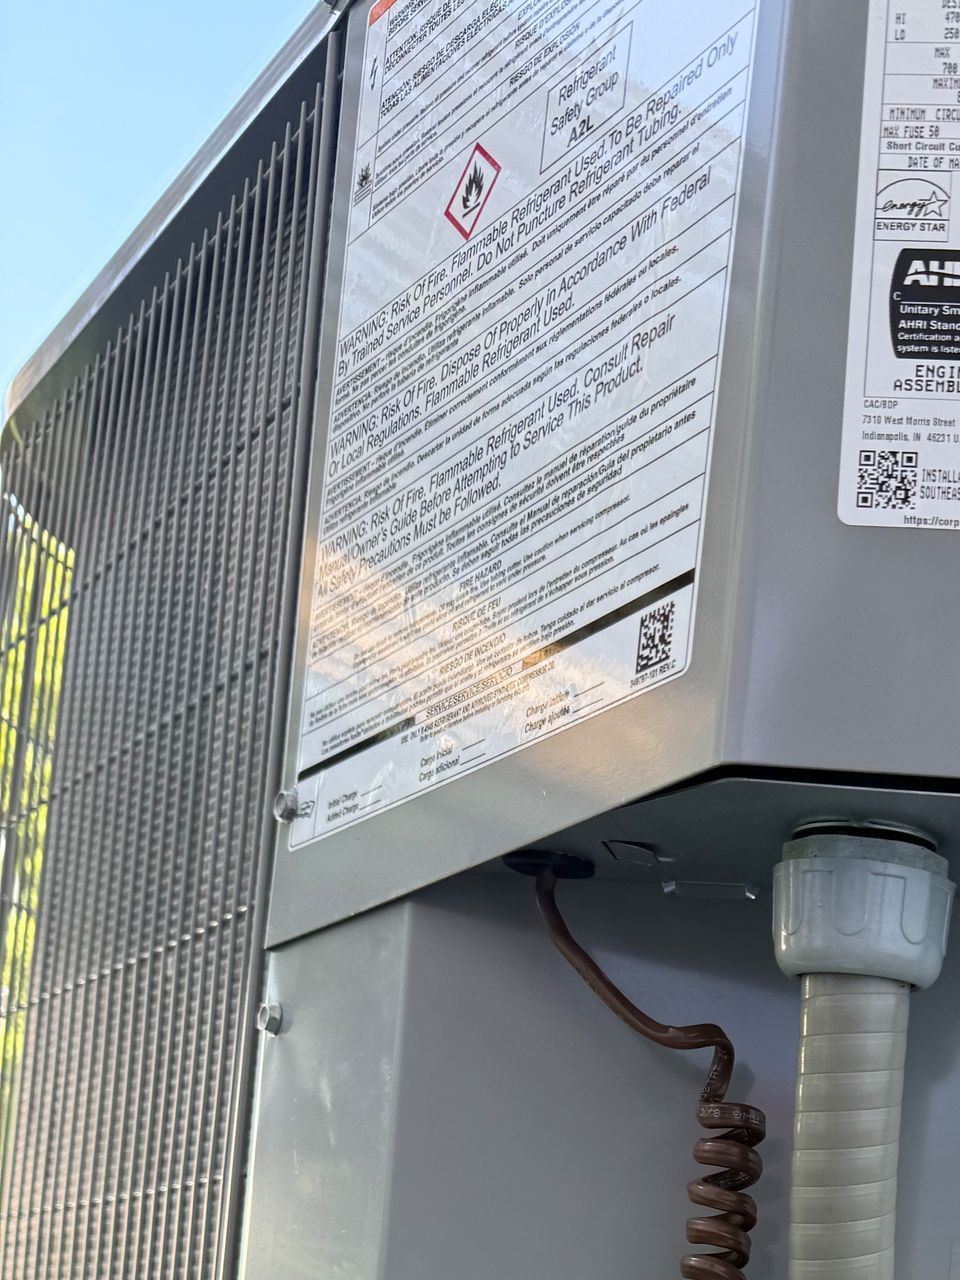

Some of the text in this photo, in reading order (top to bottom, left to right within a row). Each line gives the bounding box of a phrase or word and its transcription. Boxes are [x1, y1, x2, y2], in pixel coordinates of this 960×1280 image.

[895, 13, 906, 24] HI
[944, 12, 960, 23] 470
[944, 27, 959, 39] 250
[934, 46, 950, 57] MAX
[942, 62, 958, 74] 700
[558, 46, 616, 106] Refrigerant
[551, 72, 618, 136] Safety Group
[889, 107, 925, 120] MINIMUM
[567, 115, 594, 148] A2L
[883, 126, 899, 137] MAX
[903, 126, 924, 138] FUSE
[928, 125, 939, 137] 50
[886, 141, 911, 150] Short
[915, 142, 945, 151] Circuit
[907, 156, 929, 168] DATE
[933, 157, 944, 168] OF
[341, 311, 388, 357] WARNING:
[391, 293, 411, 319] Risk
[414, 279, 426, 301] Of
[427, 268, 448, 291] Fire.
[451, 221, 508, 273] Flammable
[511, 167, 571, 228] Refrigerant
[625, 114, 642, 137] Be
[645, 58, 703, 127] Repaired
[707, 32, 738, 68] Only
[876, 221, 945, 231] ENERGY STAR
[338, 104, 681, 377] By Trained Service Personnel. Do Not Puncture Refrigerant Tubing.
[899, 304, 939, 314] Unitary
[898, 319, 926, 329] AHRI
[897, 332, 951, 342] Certification
[896, 344, 928, 353] system
[930, 345, 938, 353] is
[884, 415, 904, 425] West
[906, 416, 930, 426] Morris
[932, 417, 955, 427] Street
[912, 432, 920, 442] IN
